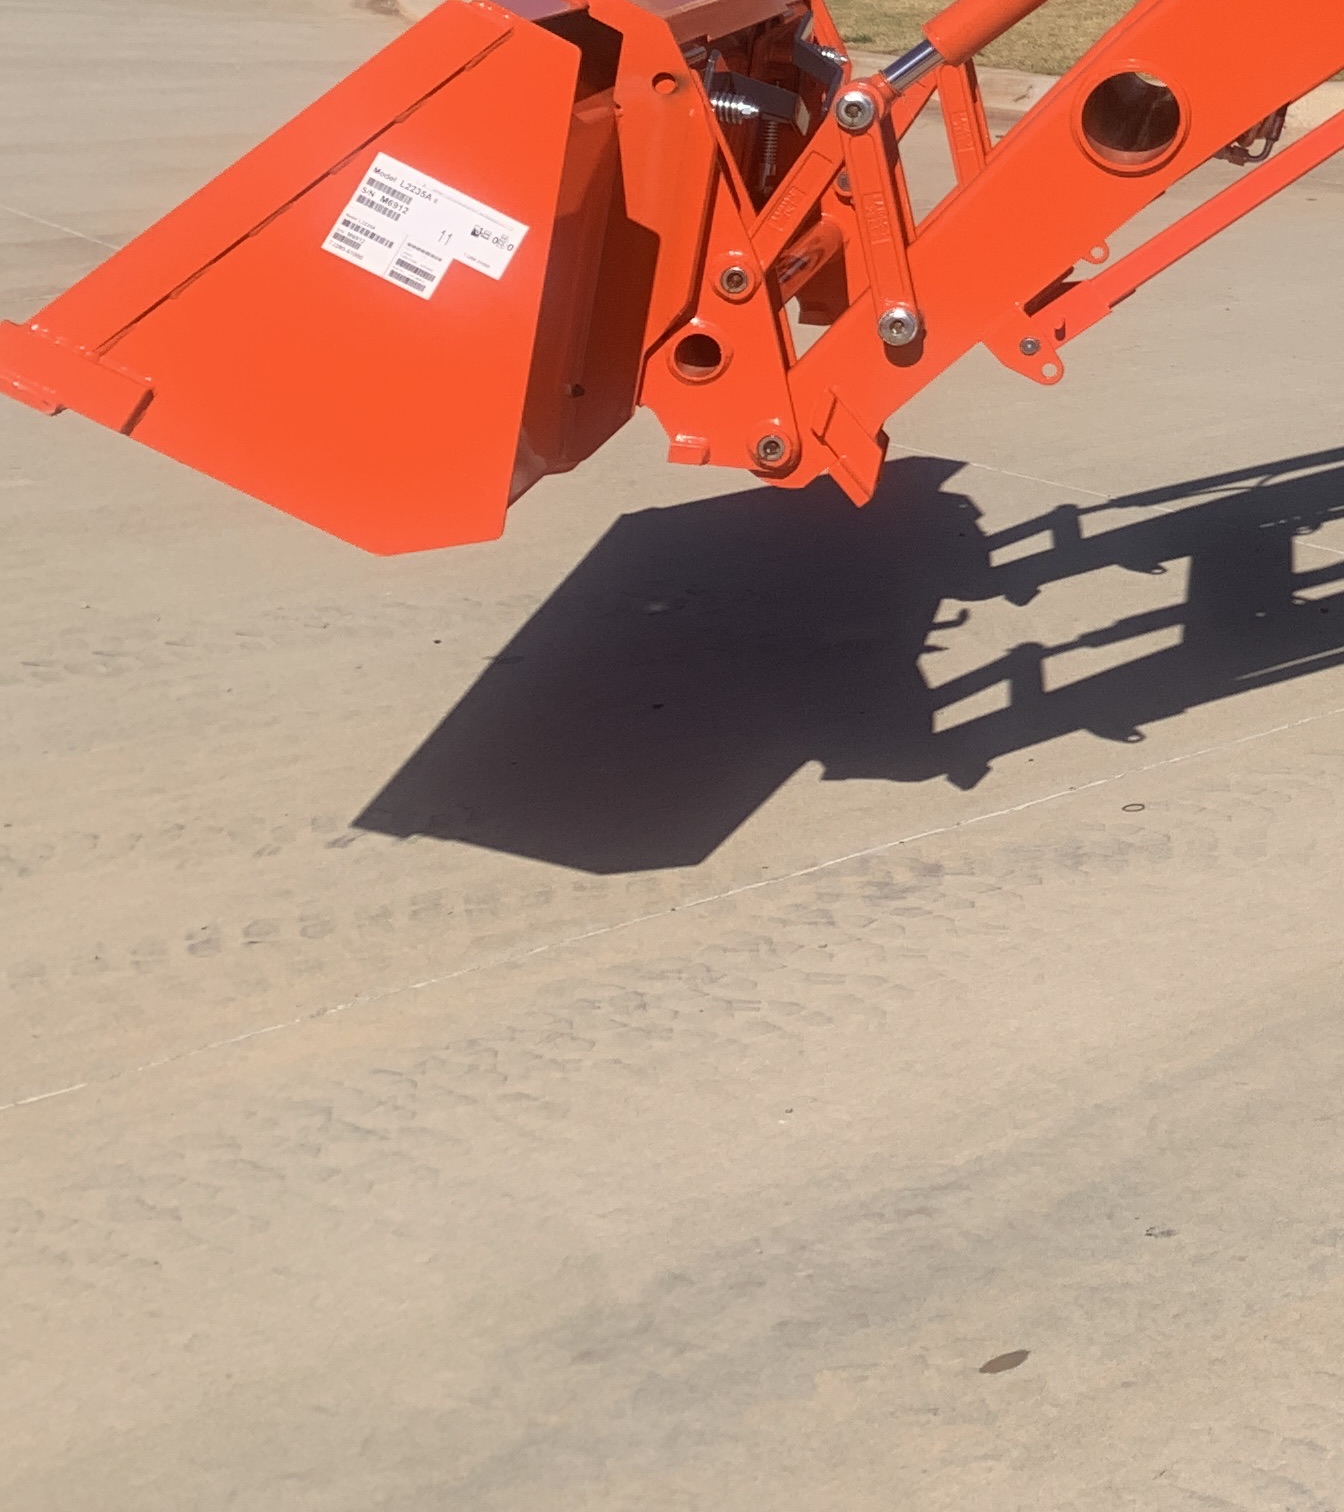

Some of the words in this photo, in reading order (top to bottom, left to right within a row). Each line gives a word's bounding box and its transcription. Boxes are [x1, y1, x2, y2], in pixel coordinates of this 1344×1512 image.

[360, 185, 375, 198] S/N
[378, 194, 409, 215] M6912
[371, 165, 398, 183] Model
[398, 179, 433, 202] L2235A
